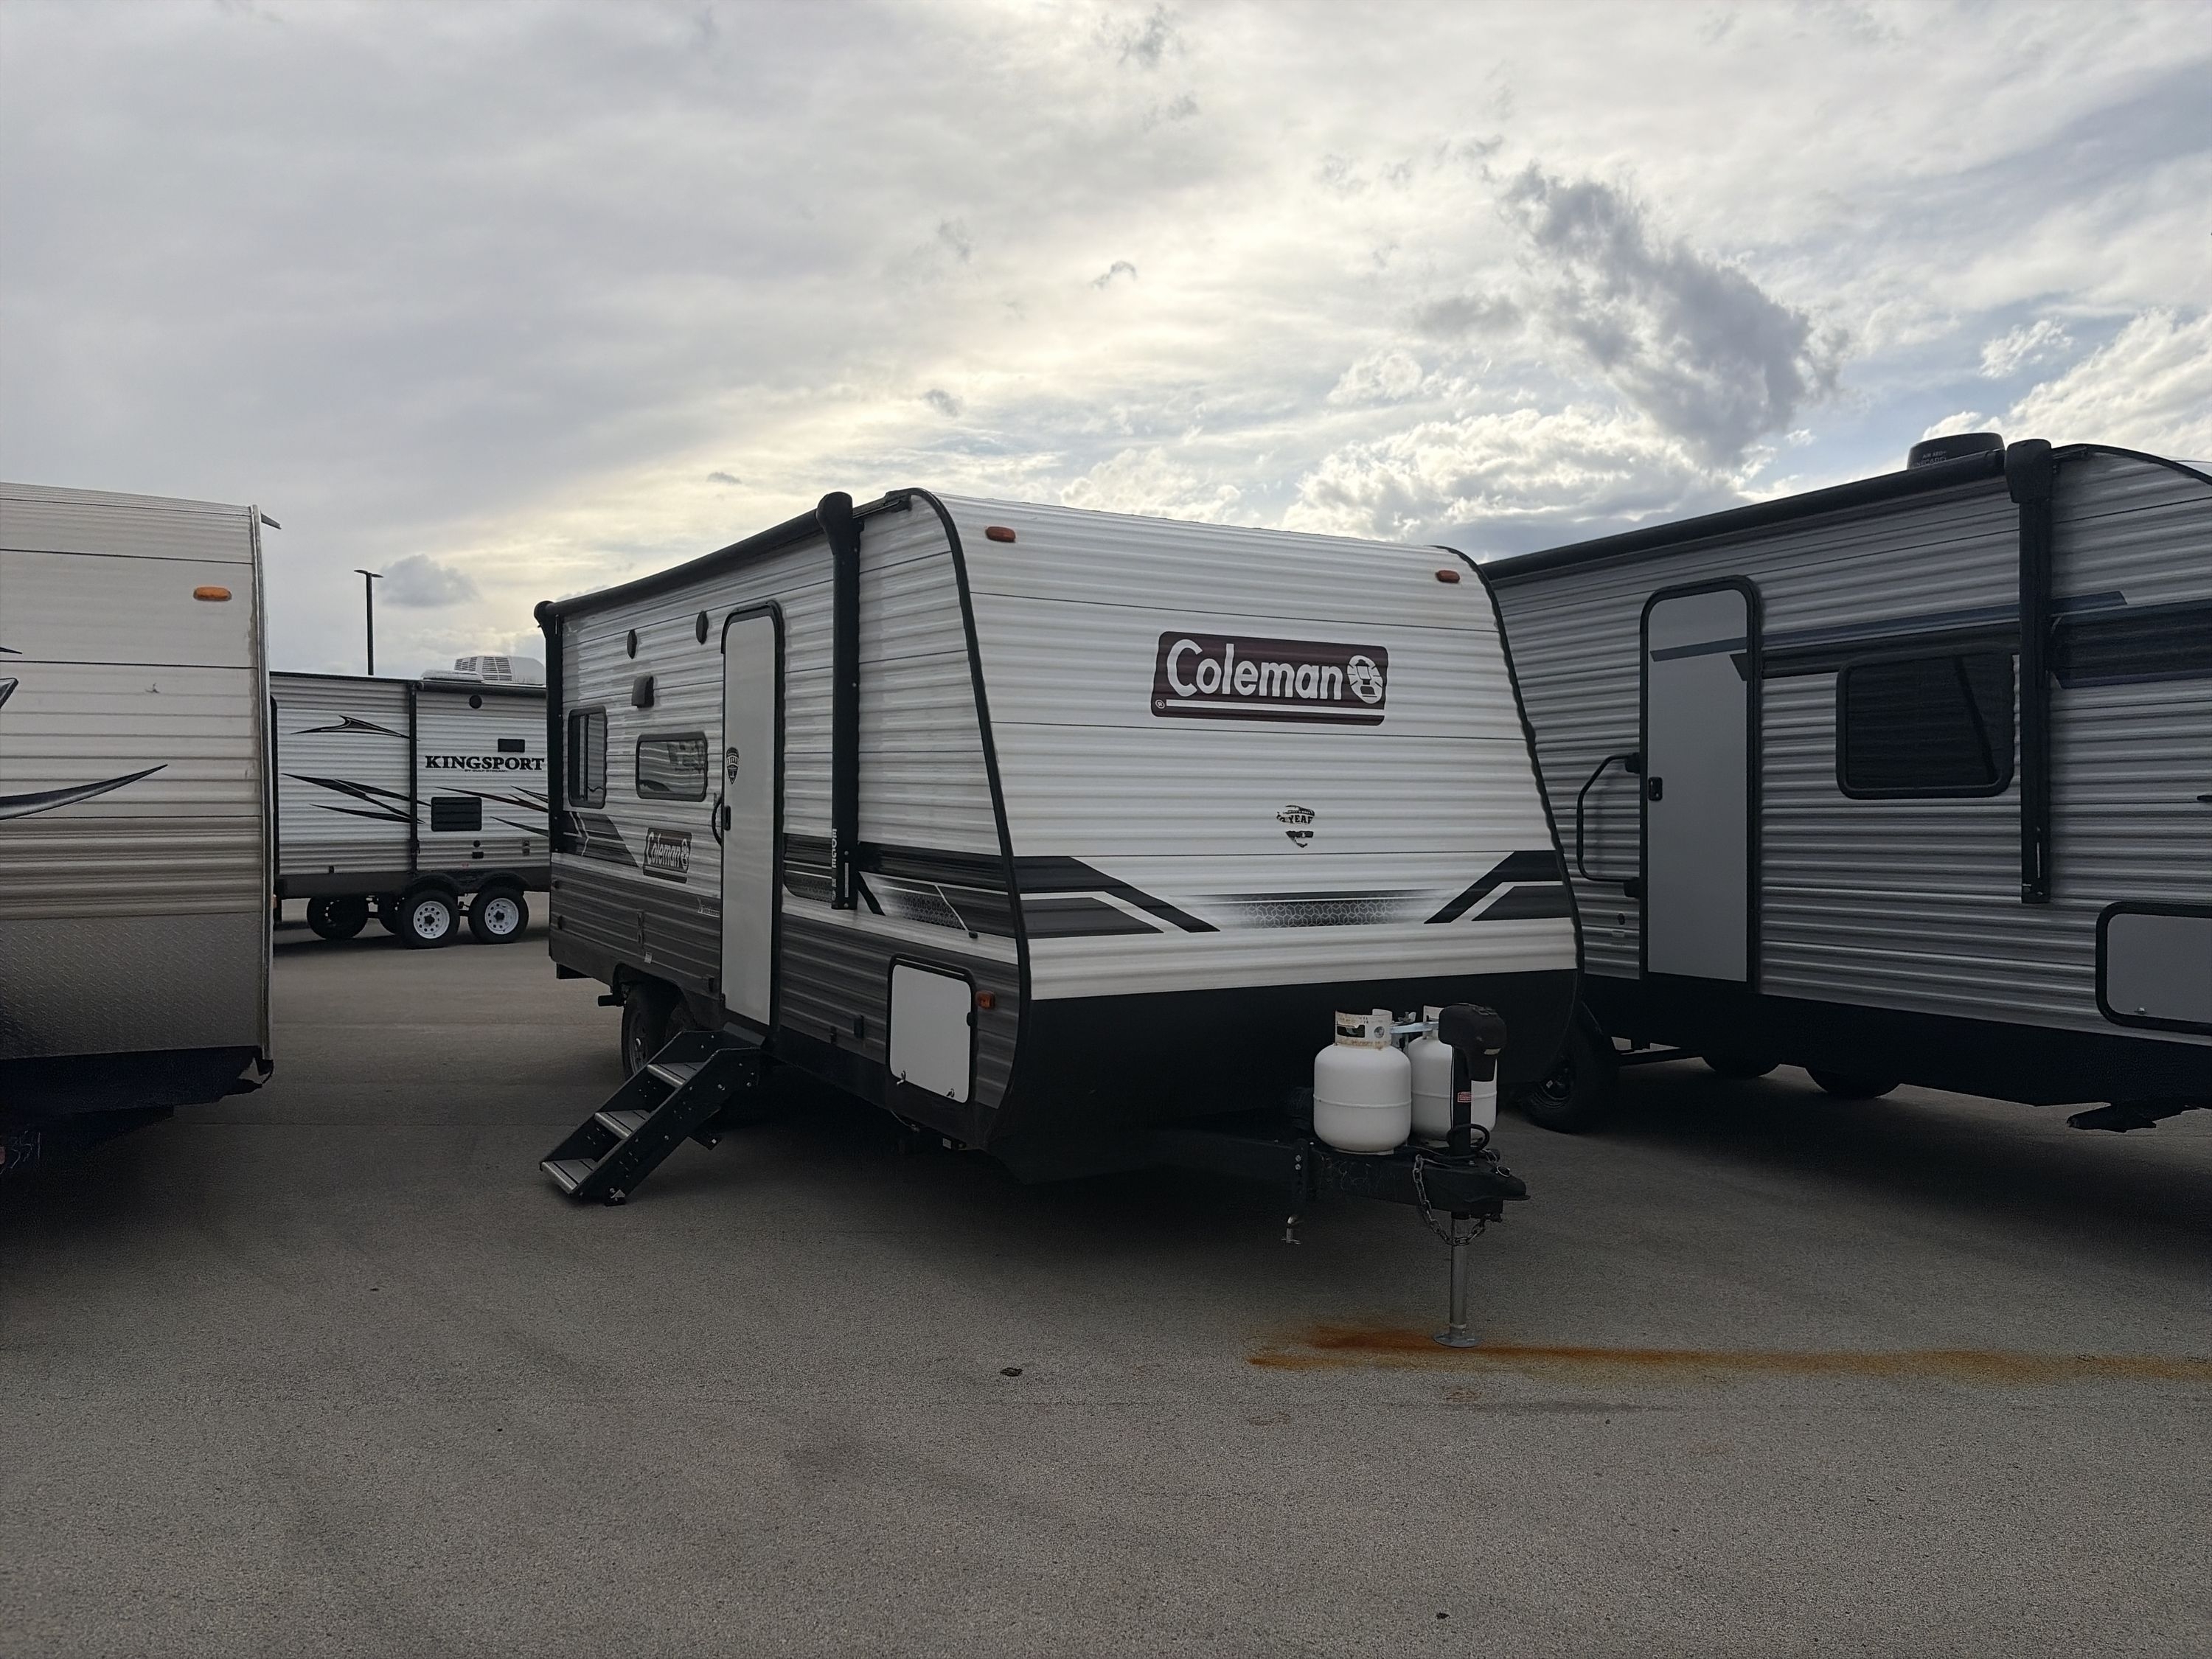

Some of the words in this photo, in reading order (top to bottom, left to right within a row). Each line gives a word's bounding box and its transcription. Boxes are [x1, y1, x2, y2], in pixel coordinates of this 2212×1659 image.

[1166, 639, 1343, 700] Coleman
[425, 756, 545, 771] KINGSPORT
[646, 831, 681, 869] Coleman
